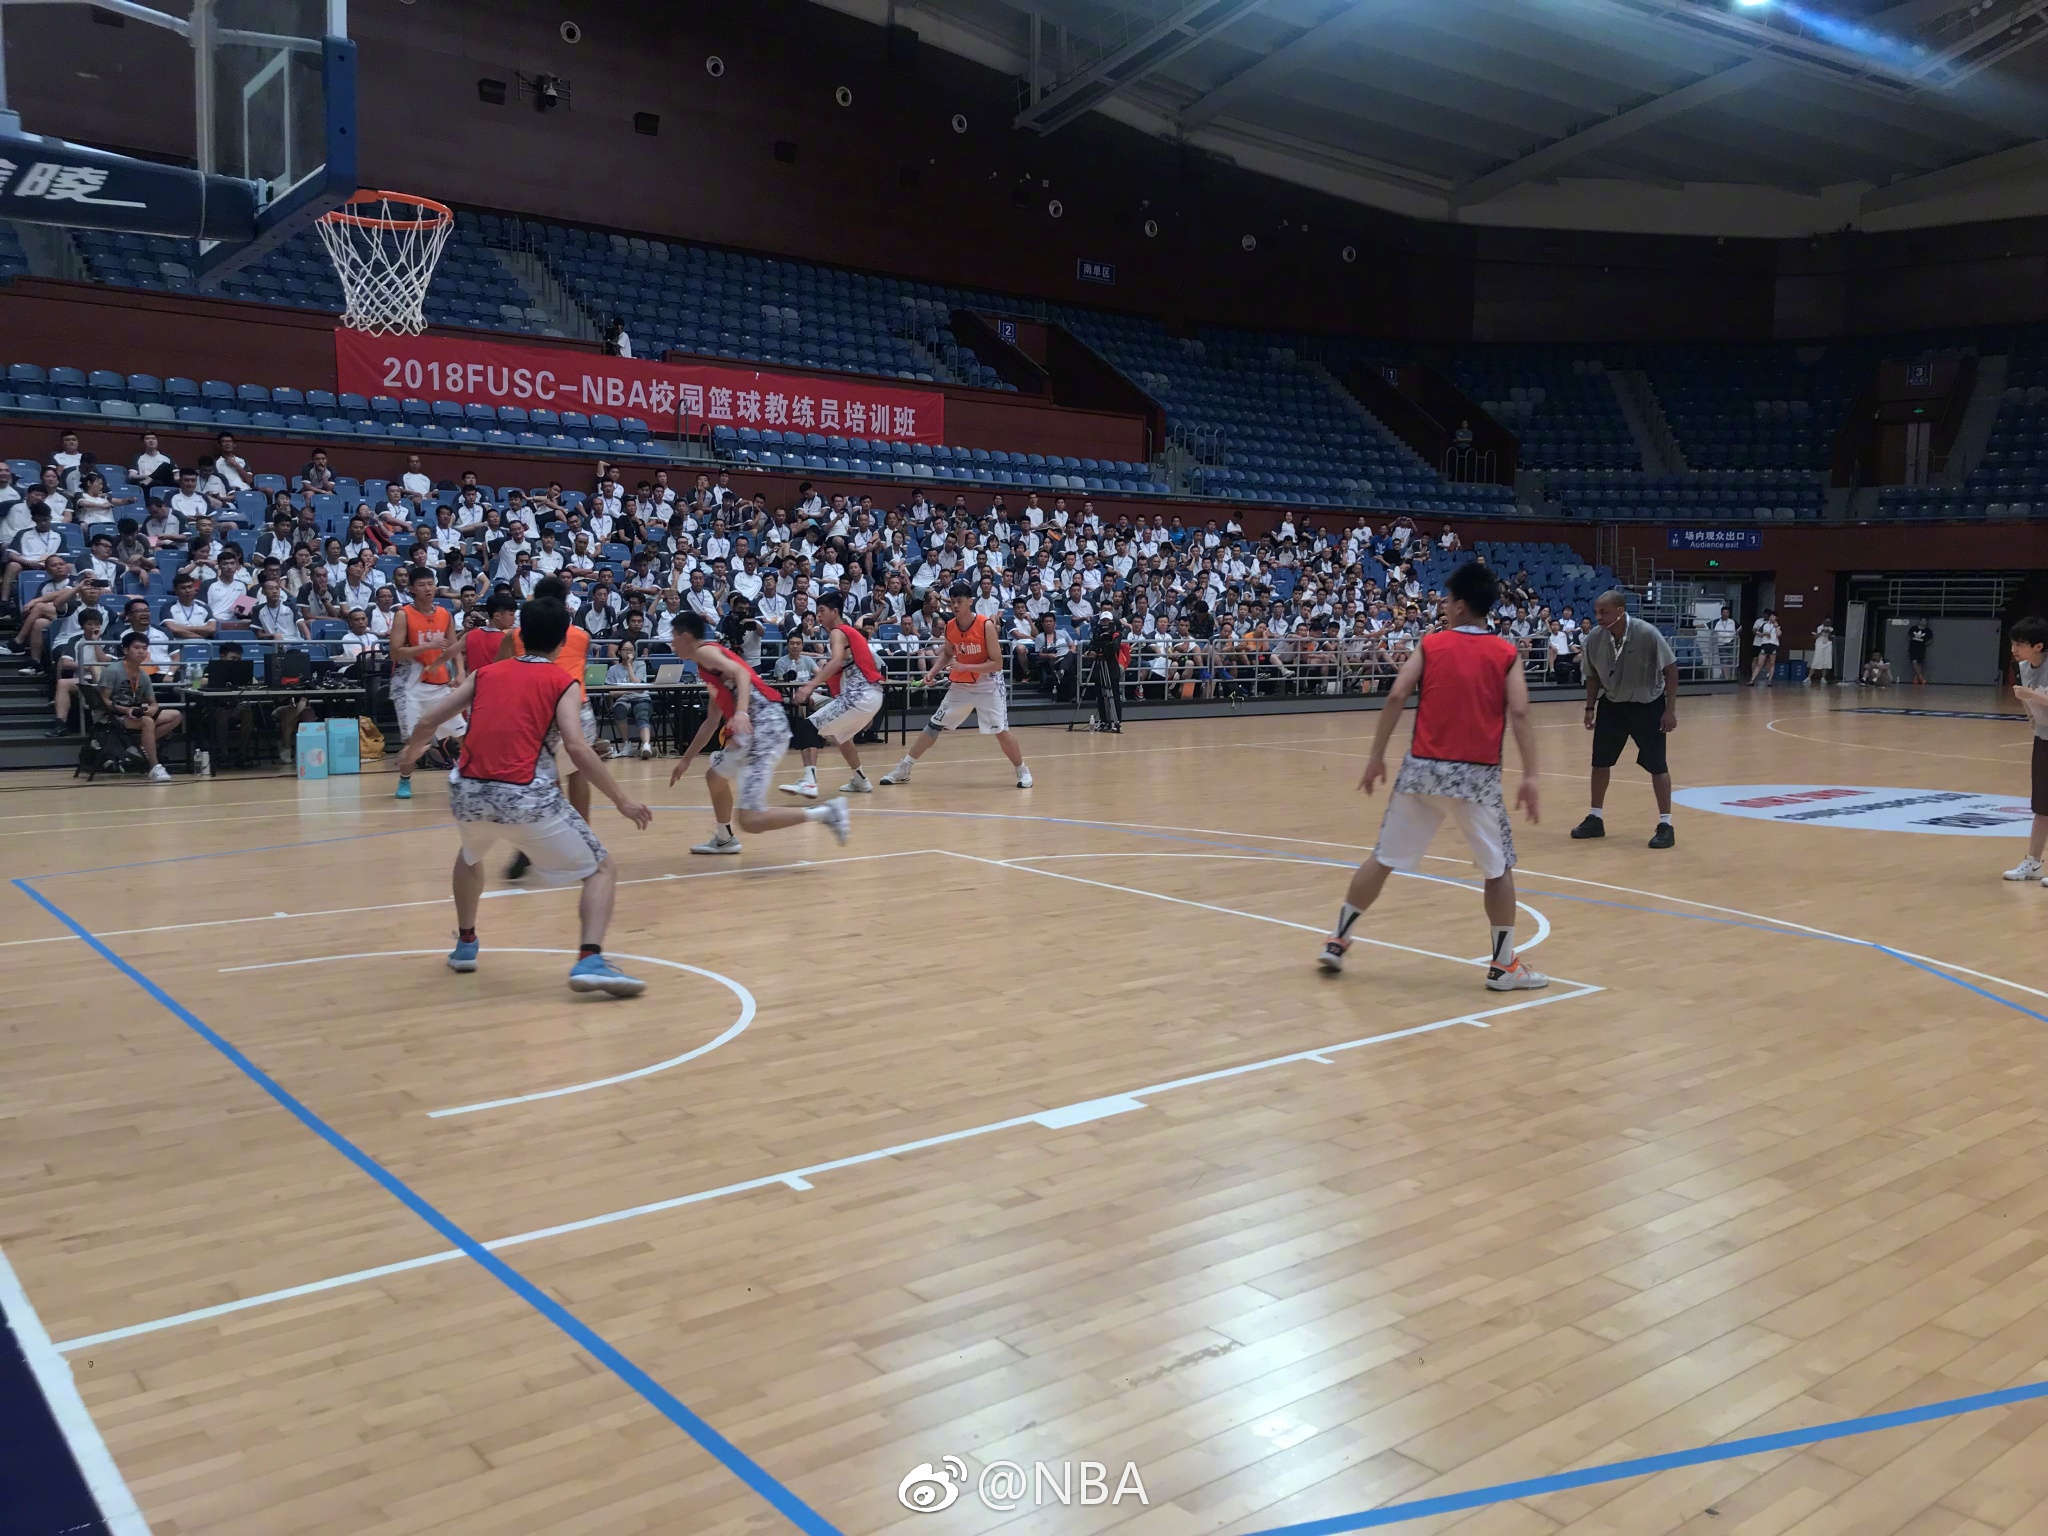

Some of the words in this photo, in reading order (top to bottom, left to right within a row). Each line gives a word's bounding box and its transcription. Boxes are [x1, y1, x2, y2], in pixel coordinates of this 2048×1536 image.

[1005, 325, 1011, 335] 2
[383, 356, 916, 437] 2018FUSC-NBA校园篮球教练员培训班
[1685, 531, 1745, 541] 场内观众出口
[1750, 535, 1756, 544] 1
[1689, 541, 1723, 549] Audience
[1725, 541, 1739, 549] exit
